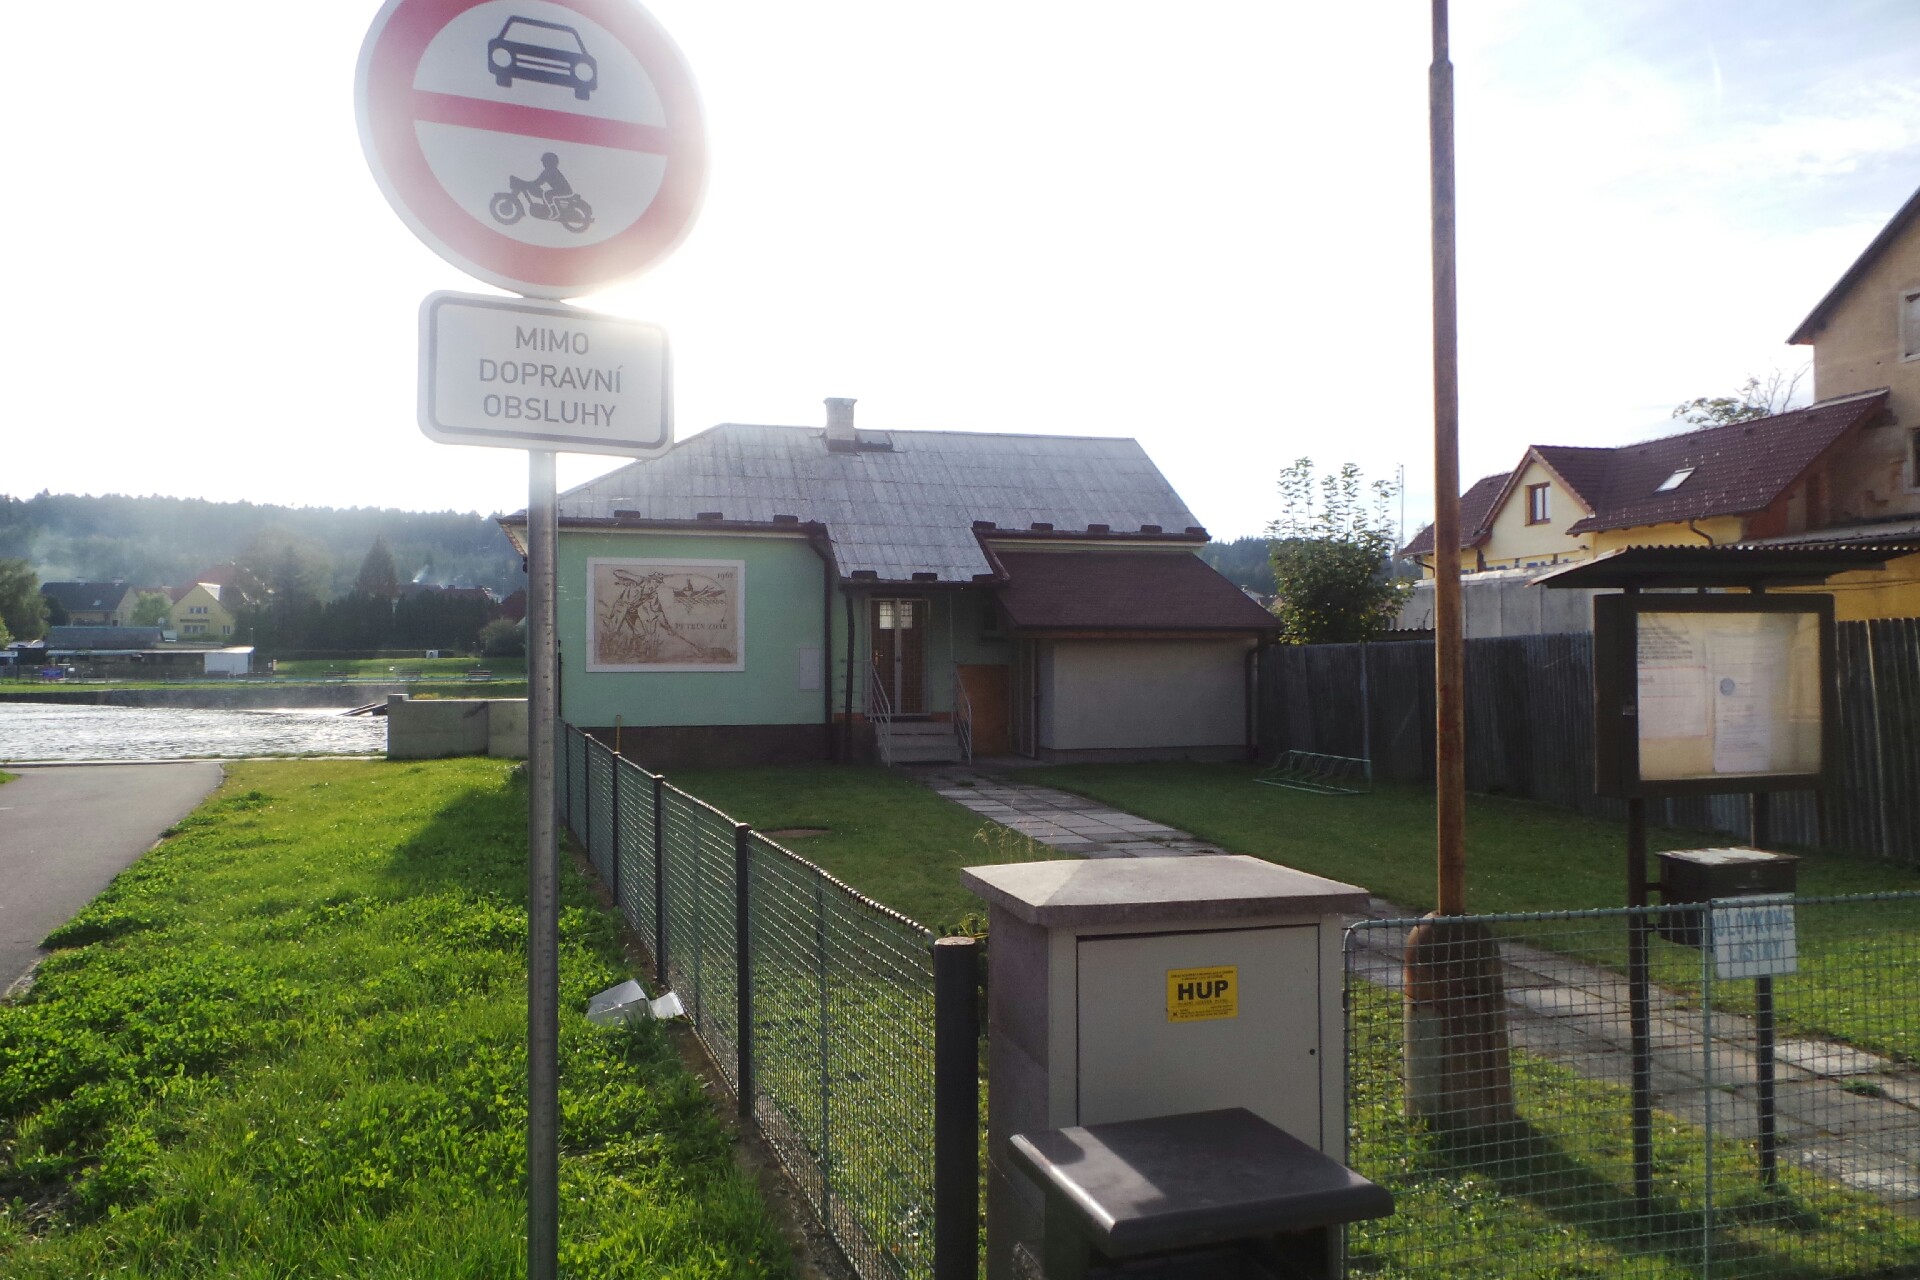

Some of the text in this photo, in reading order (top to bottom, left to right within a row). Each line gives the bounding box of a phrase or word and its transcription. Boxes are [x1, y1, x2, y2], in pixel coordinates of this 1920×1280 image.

[515, 325, 589, 355] MIMO
[479, 358, 623, 393] DOPRAVNÍ
[483, 393, 616, 427] OBSLUHY
[1177, 980, 1229, 1001] HUP
